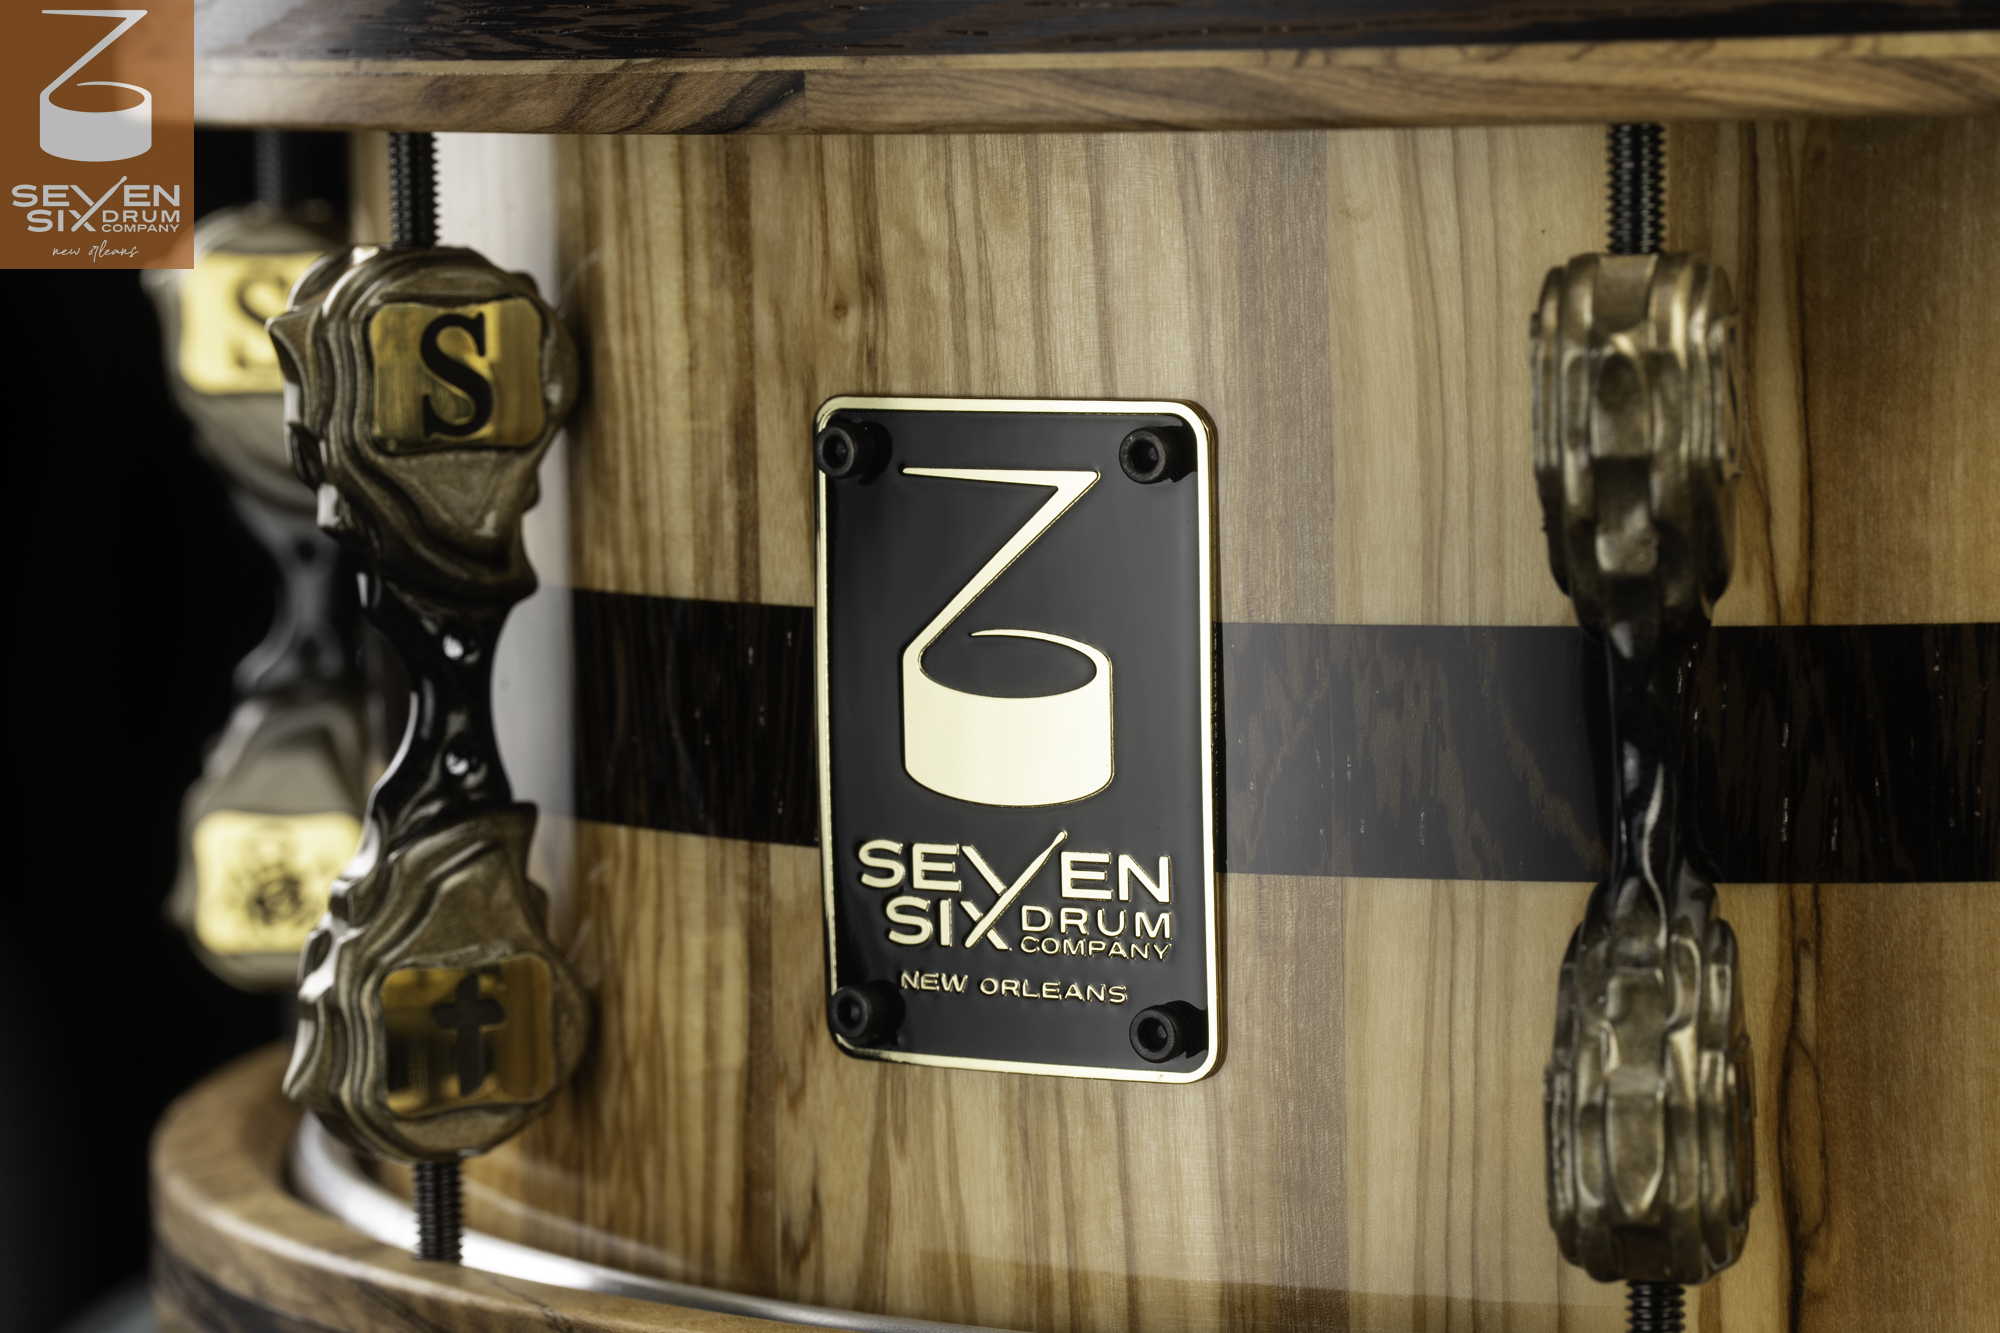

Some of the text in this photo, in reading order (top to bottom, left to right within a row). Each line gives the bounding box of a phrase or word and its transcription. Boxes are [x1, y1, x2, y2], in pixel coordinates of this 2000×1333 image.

[420, 312, 493, 438] S
[858, 830, 1171, 904] SEVEN
[885, 896, 1172, 950] SIX DRUM
[1019, 935, 1172, 961] COMPANY
[900, 970, 1128, 1005] NEW ORLEANS
